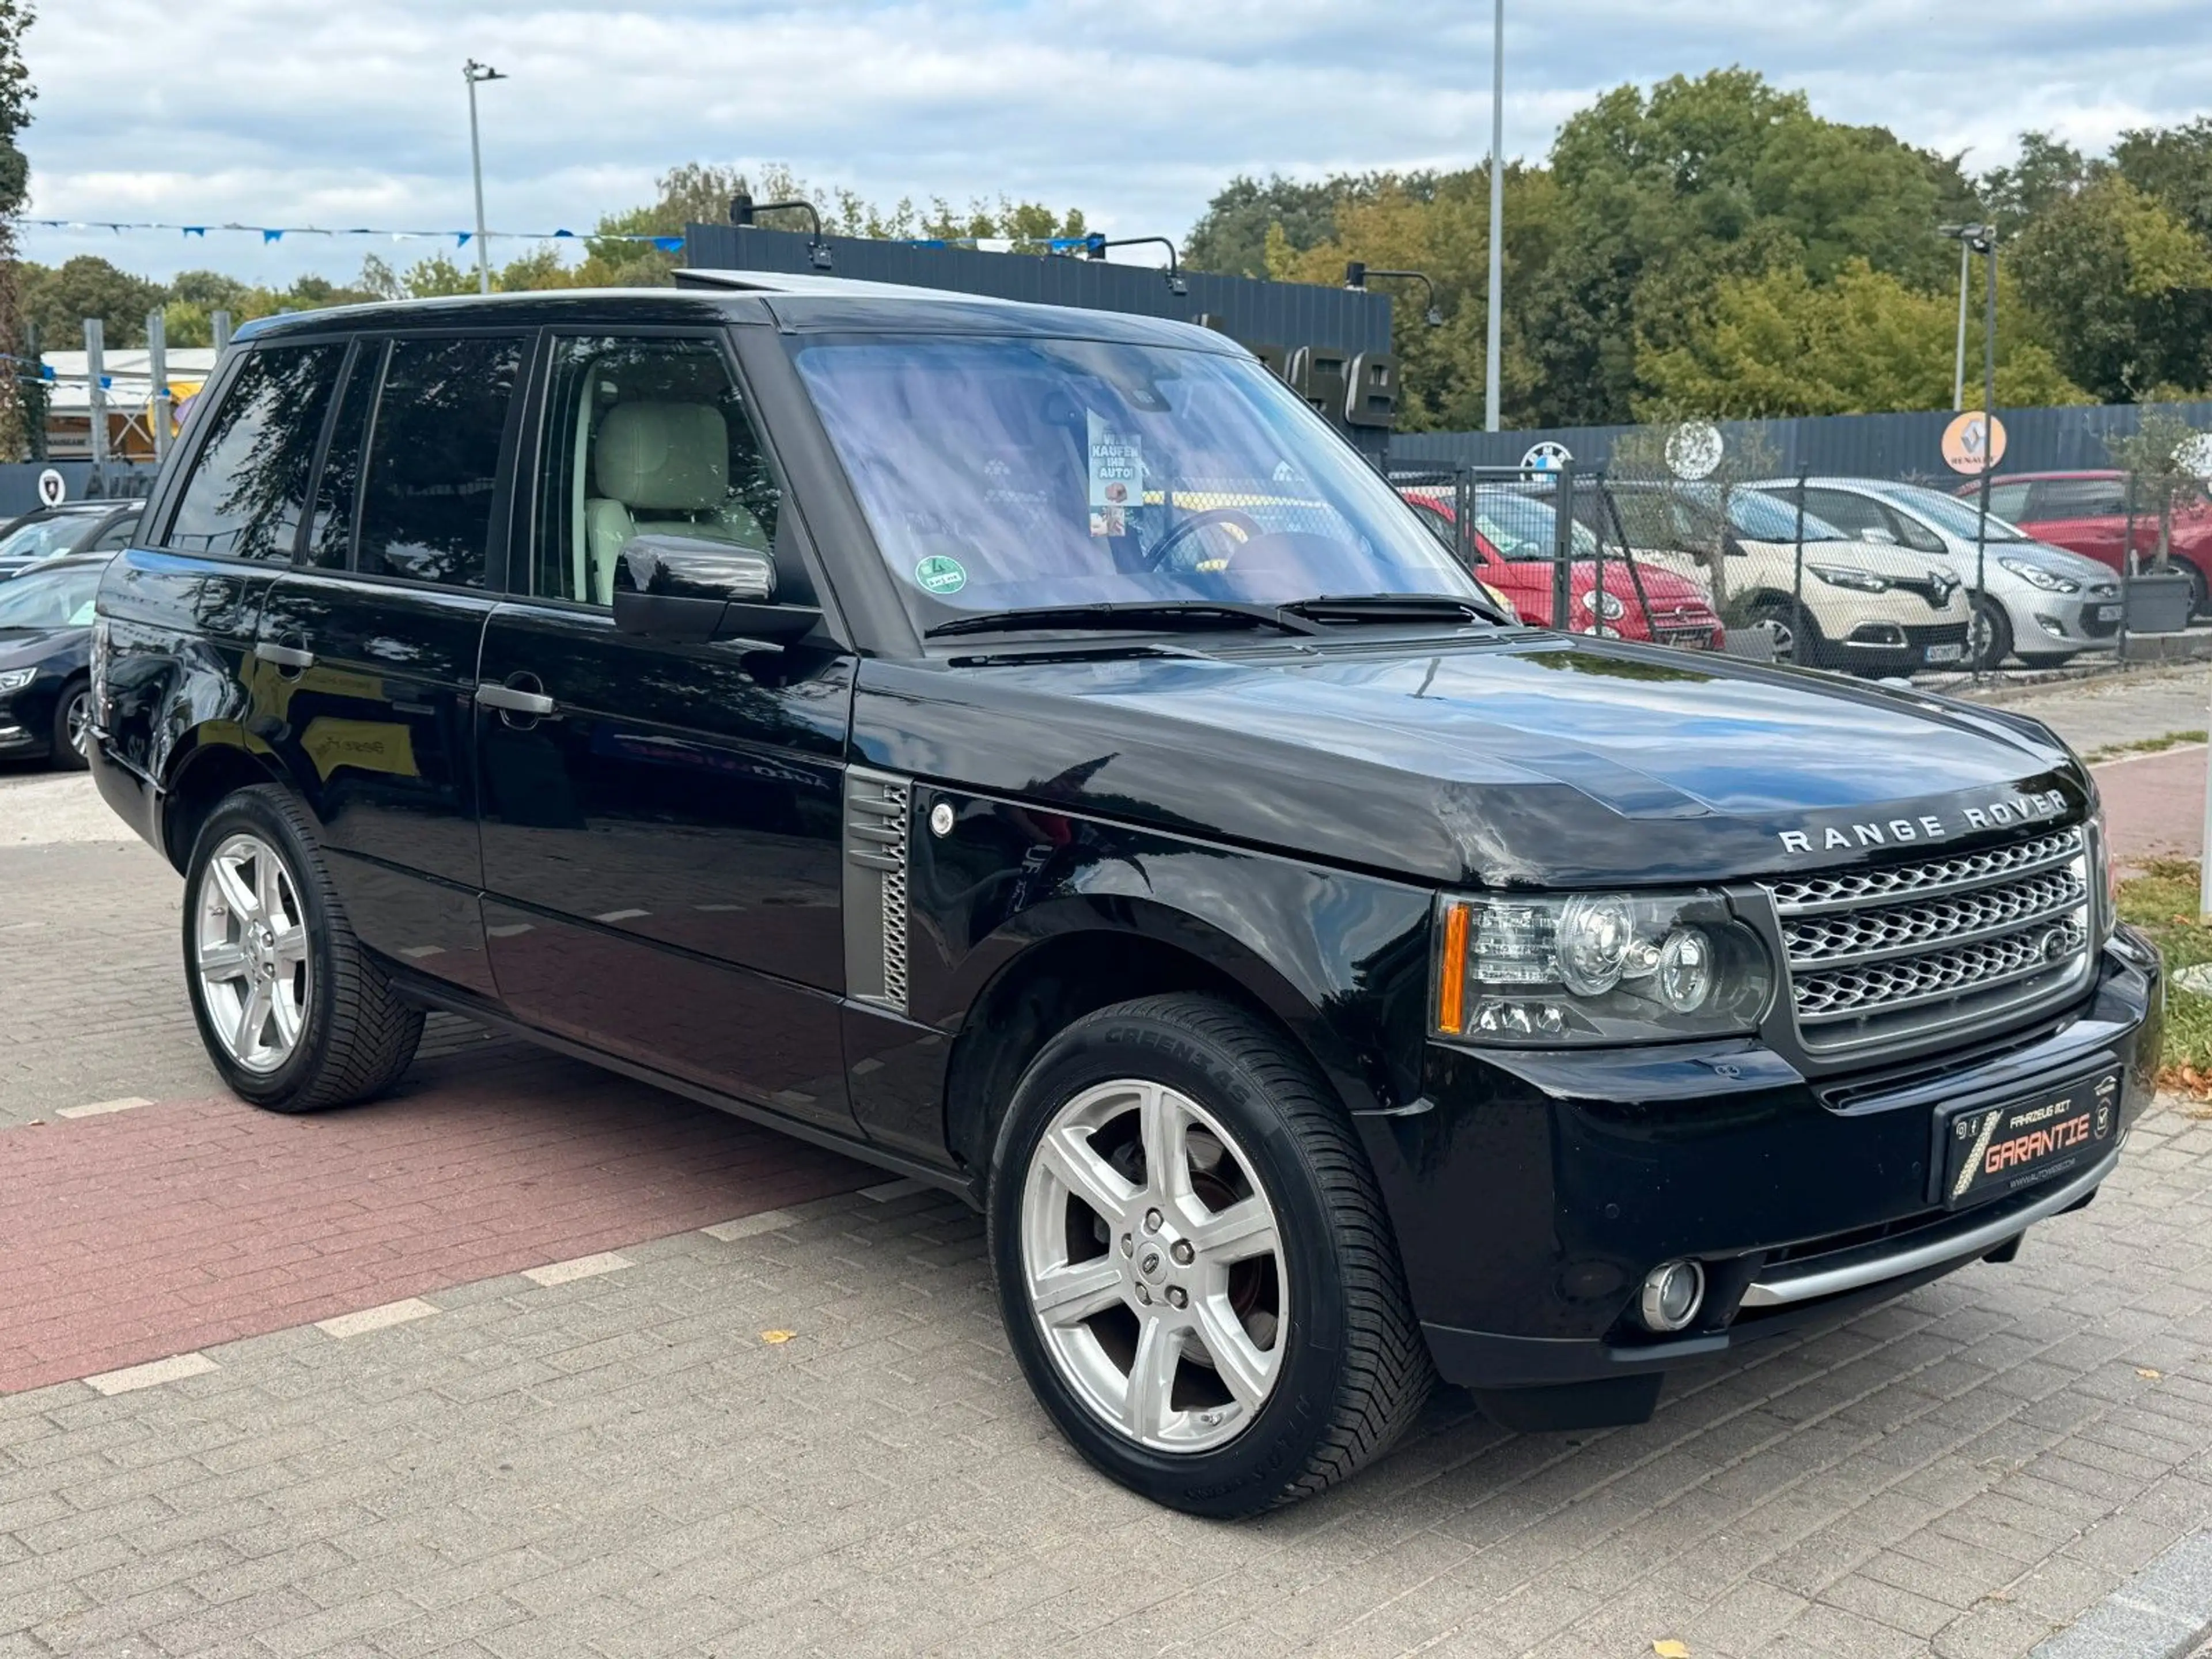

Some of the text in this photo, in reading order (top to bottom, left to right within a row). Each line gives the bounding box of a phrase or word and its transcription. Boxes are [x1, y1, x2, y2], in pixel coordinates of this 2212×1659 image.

[1092, 445, 1139, 457] KAUFEN
[1779, 789, 2067, 853] RANGE ROVER
[2010, 1105, 2054, 1129] FAHRZEUG
[1985, 1113, 2090, 1173] GARANTIE
